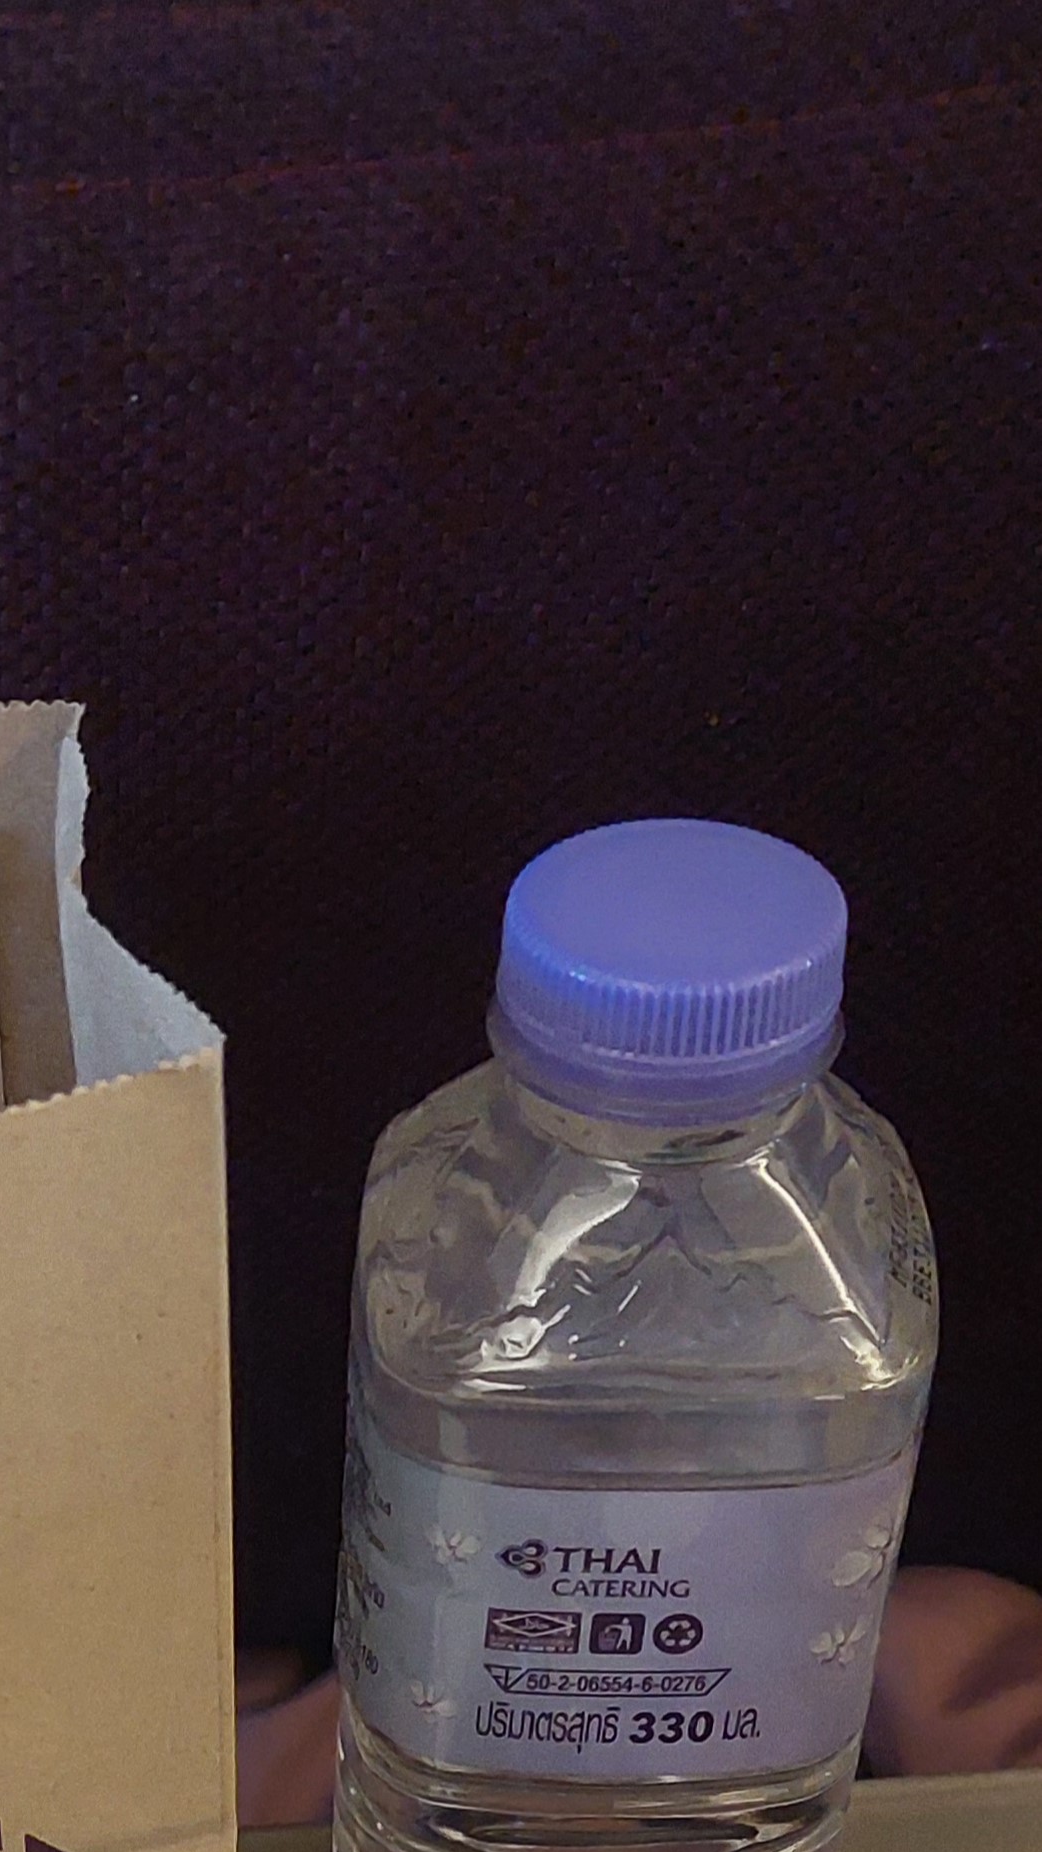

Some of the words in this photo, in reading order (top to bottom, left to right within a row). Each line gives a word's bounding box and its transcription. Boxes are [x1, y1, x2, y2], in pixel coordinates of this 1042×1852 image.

[552, 1547, 661, 1575] THAI
[551, 1578, 691, 1599] CATERING
[526, 1673, 706, 1693] 50-2-06554-6-0276
[628, 1711, 715, 1744] 330
[721, 1706, 761, 1741] มล.
